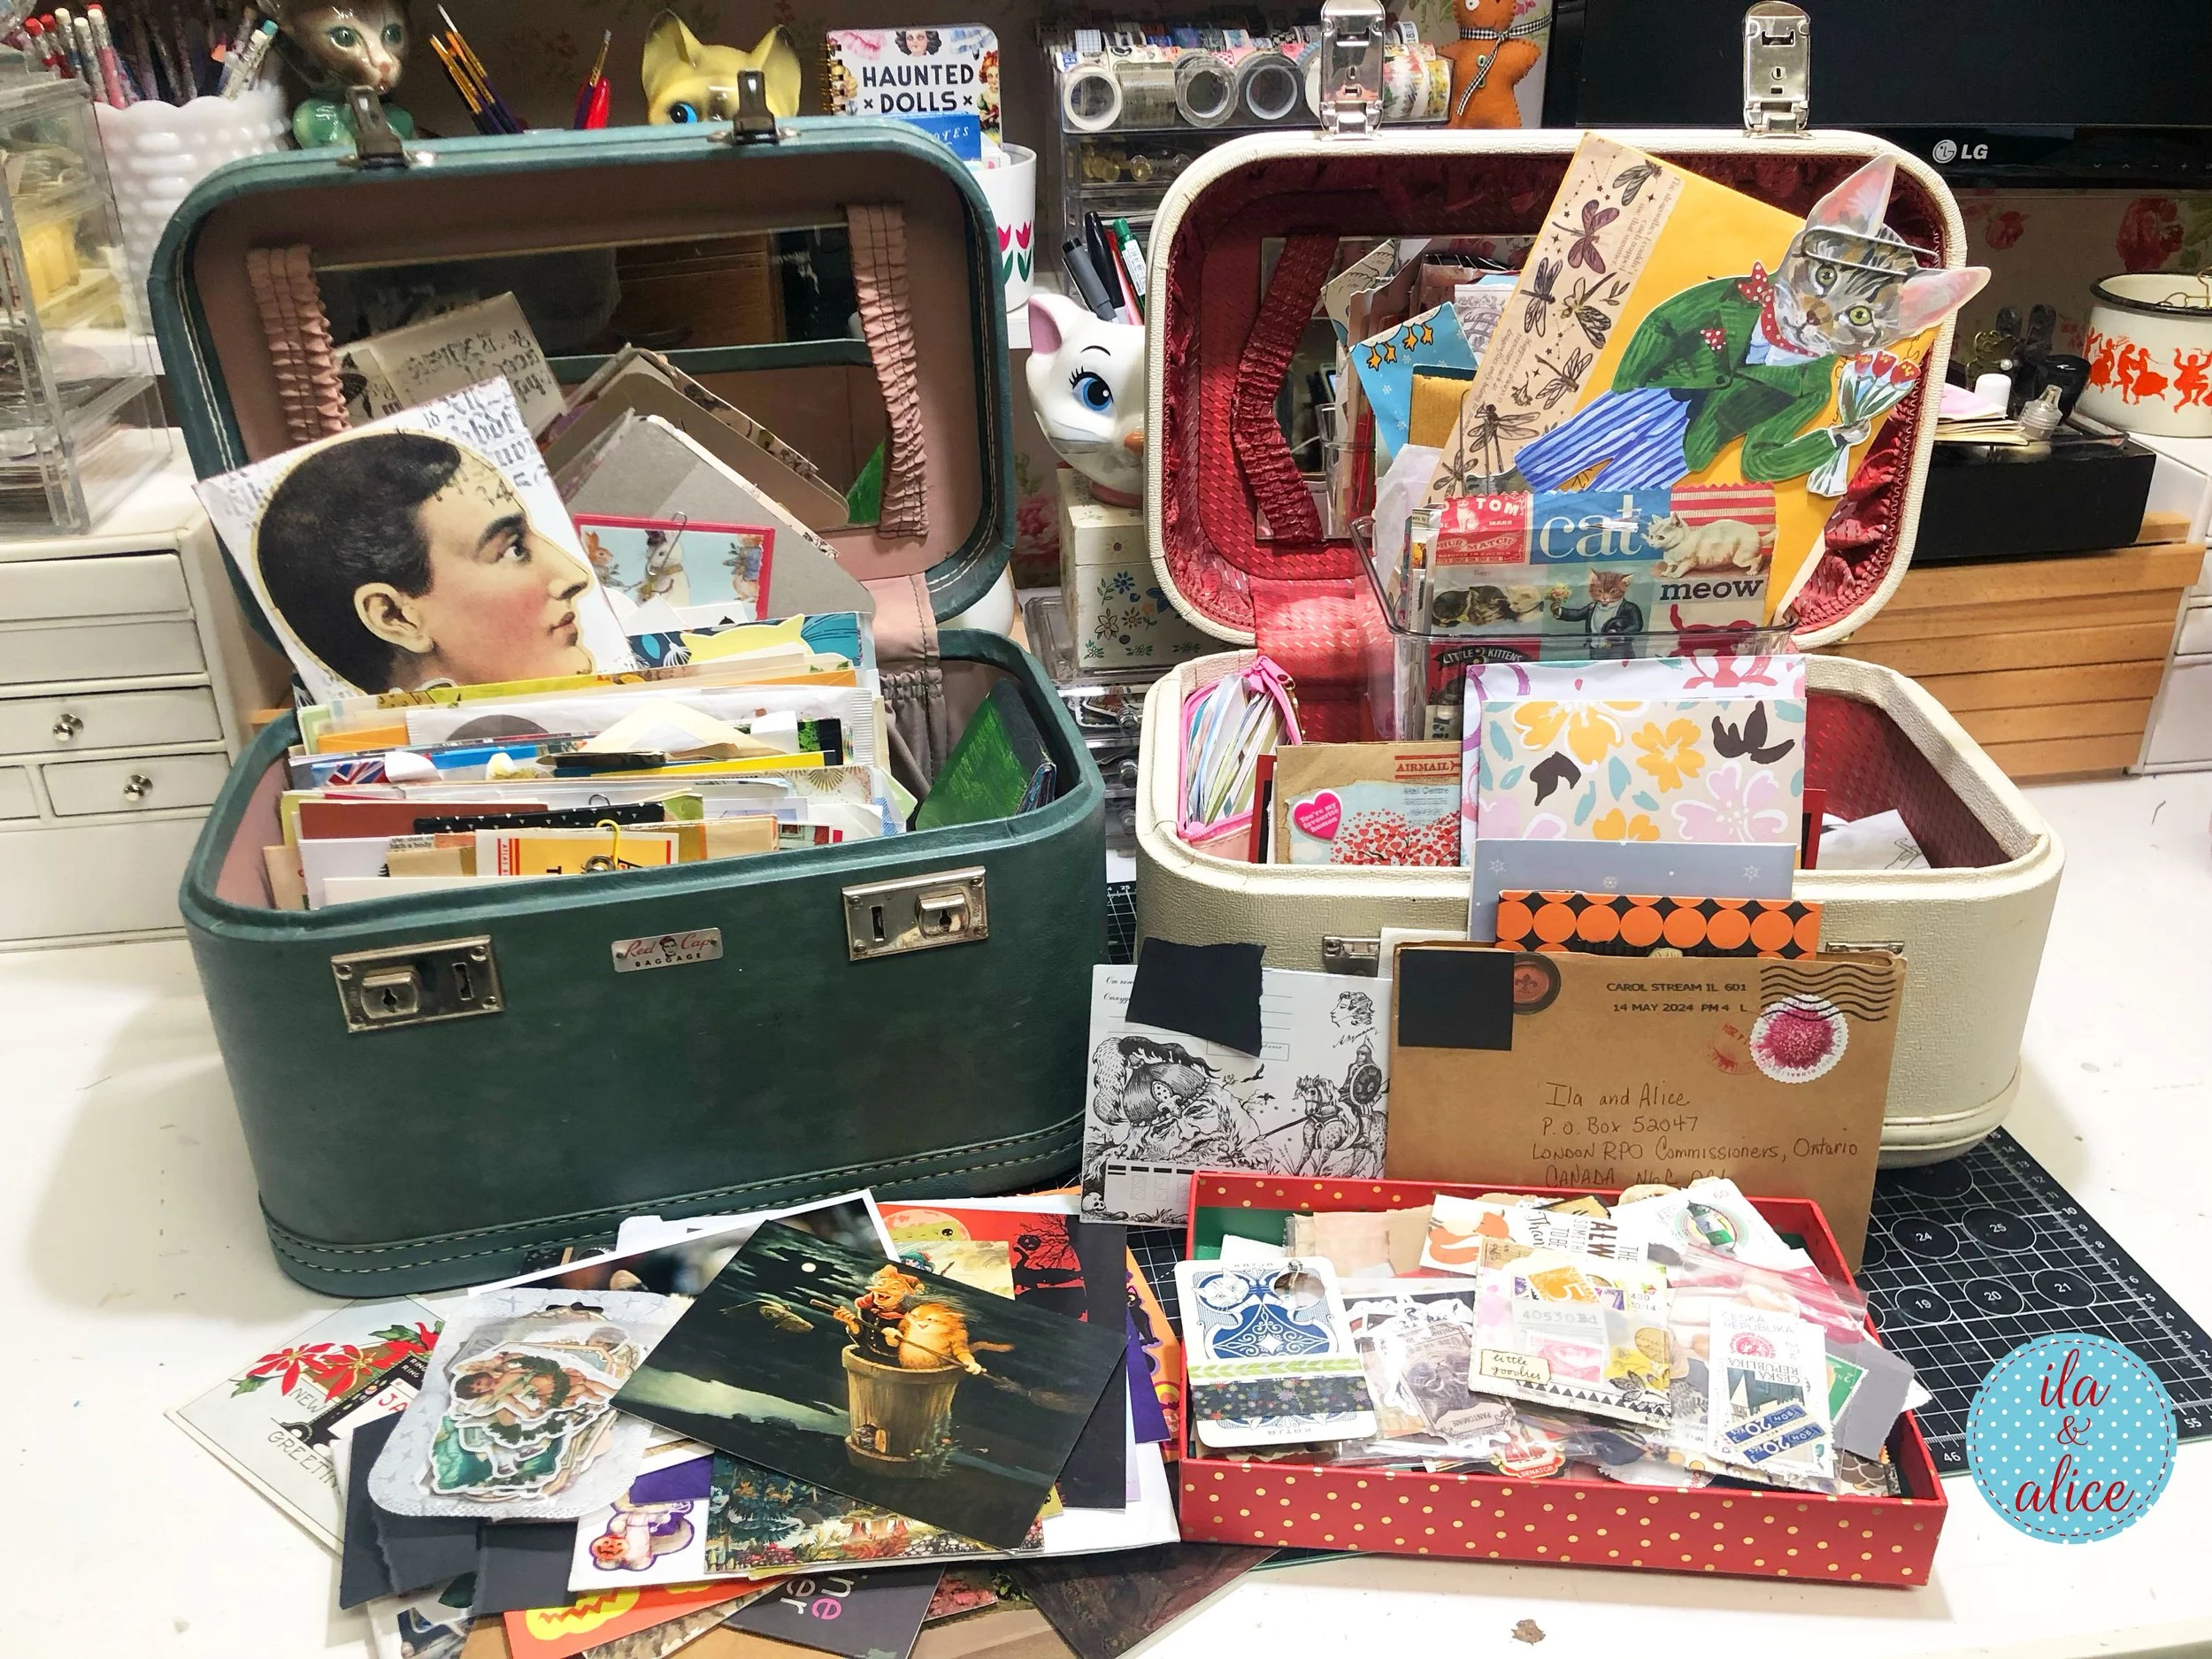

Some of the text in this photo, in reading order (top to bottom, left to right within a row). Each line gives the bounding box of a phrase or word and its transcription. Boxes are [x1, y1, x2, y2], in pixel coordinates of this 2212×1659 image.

[862, 64, 973, 88] HAUNTED
[880, 91, 957, 113] DOLLS
[933, 126, 970, 139] OTES
[1961, 144, 1988, 159] LG
[1476, 498, 1520, 516] TOM
[1539, 495, 1643, 558] cat
[1467, 536, 1516, 550] MATCH
[1660, 580, 1763, 601] meow
[1442, 649, 1473, 664] LITTLE
[1488, 649, 1523, 662] KITTENS
[1396, 763, 1448, 772] AIRMAIL
[1299, 802, 1337, 824] You're my
[1303, 809, 1339, 829] favourite
[1311, 817, 1337, 833] human
[625, 940, 657, 958] Red
[635, 953, 702, 967] BAGGAGE
[1607, 983, 1747, 992] CAROL STREAM IL 601
[1613, 1003, 1628, 1012] 14
[1632, 1003, 1659, 1012] MAY
[1663, 1003, 1694, 1012] 2024
[1546, 1081, 1690, 1107] Ila and Alice
[1587, 1115, 1621, 1133] Box
[1632, 1116, 1698, 1133] 52047
[1603, 1141, 1643, 1161] RPO
[1655, 1135, 1786, 1163] Commissioners,
[1793, 1138, 1858, 1156] Ontario
[2001, 1145, 2016, 1154] 14
[2017, 1160, 2030, 1169] 13
[1546, 1164, 1616, 1188] CANADA
[2032, 1175, 2046, 1184] 12
[2062, 1206, 2078, 1217] 10
[1550, 1228, 1570, 1238] TO
[1989, 1223, 2008, 1233] 25
[2079, 1223, 2088, 1233] 9
[1916, 1232, 1933, 1242] 24
[2094, 1240, 2106, 1249] 8
[1617, 1246, 1639, 1263] THE
[2110, 1257, 2120, 1266] 7
[2129, 1275, 2139, 1285] 6
[2054, 1282, 2072, 1293] 21
[1984, 1291, 2002, 1302] 20
[2145, 1292, 2156, 1302] 5
[1915, 1299, 1932, 1310] 19
[2165, 1311, 2176, 1321] 4
[2181, 1330, 2193, 1340] 3
[1492, 1354, 1528, 1366] little
[2200, 1349, 2212, 1360] 2
[402, 1363, 419, 1379] RING
[1491, 1365, 1540, 1380] goodies
[1728, 1357, 1799, 1376] REPUBLIKA
[288, 1387, 325, 1414] NEW
[1745, 1417, 1772, 1435] 20
[2184, 1417, 2203, 1429] 55
[1763, 1435, 1790, 1454] 20
[1943, 1452, 1962, 1463] 46
[1519, 1465, 1555, 1477] SENATOR
